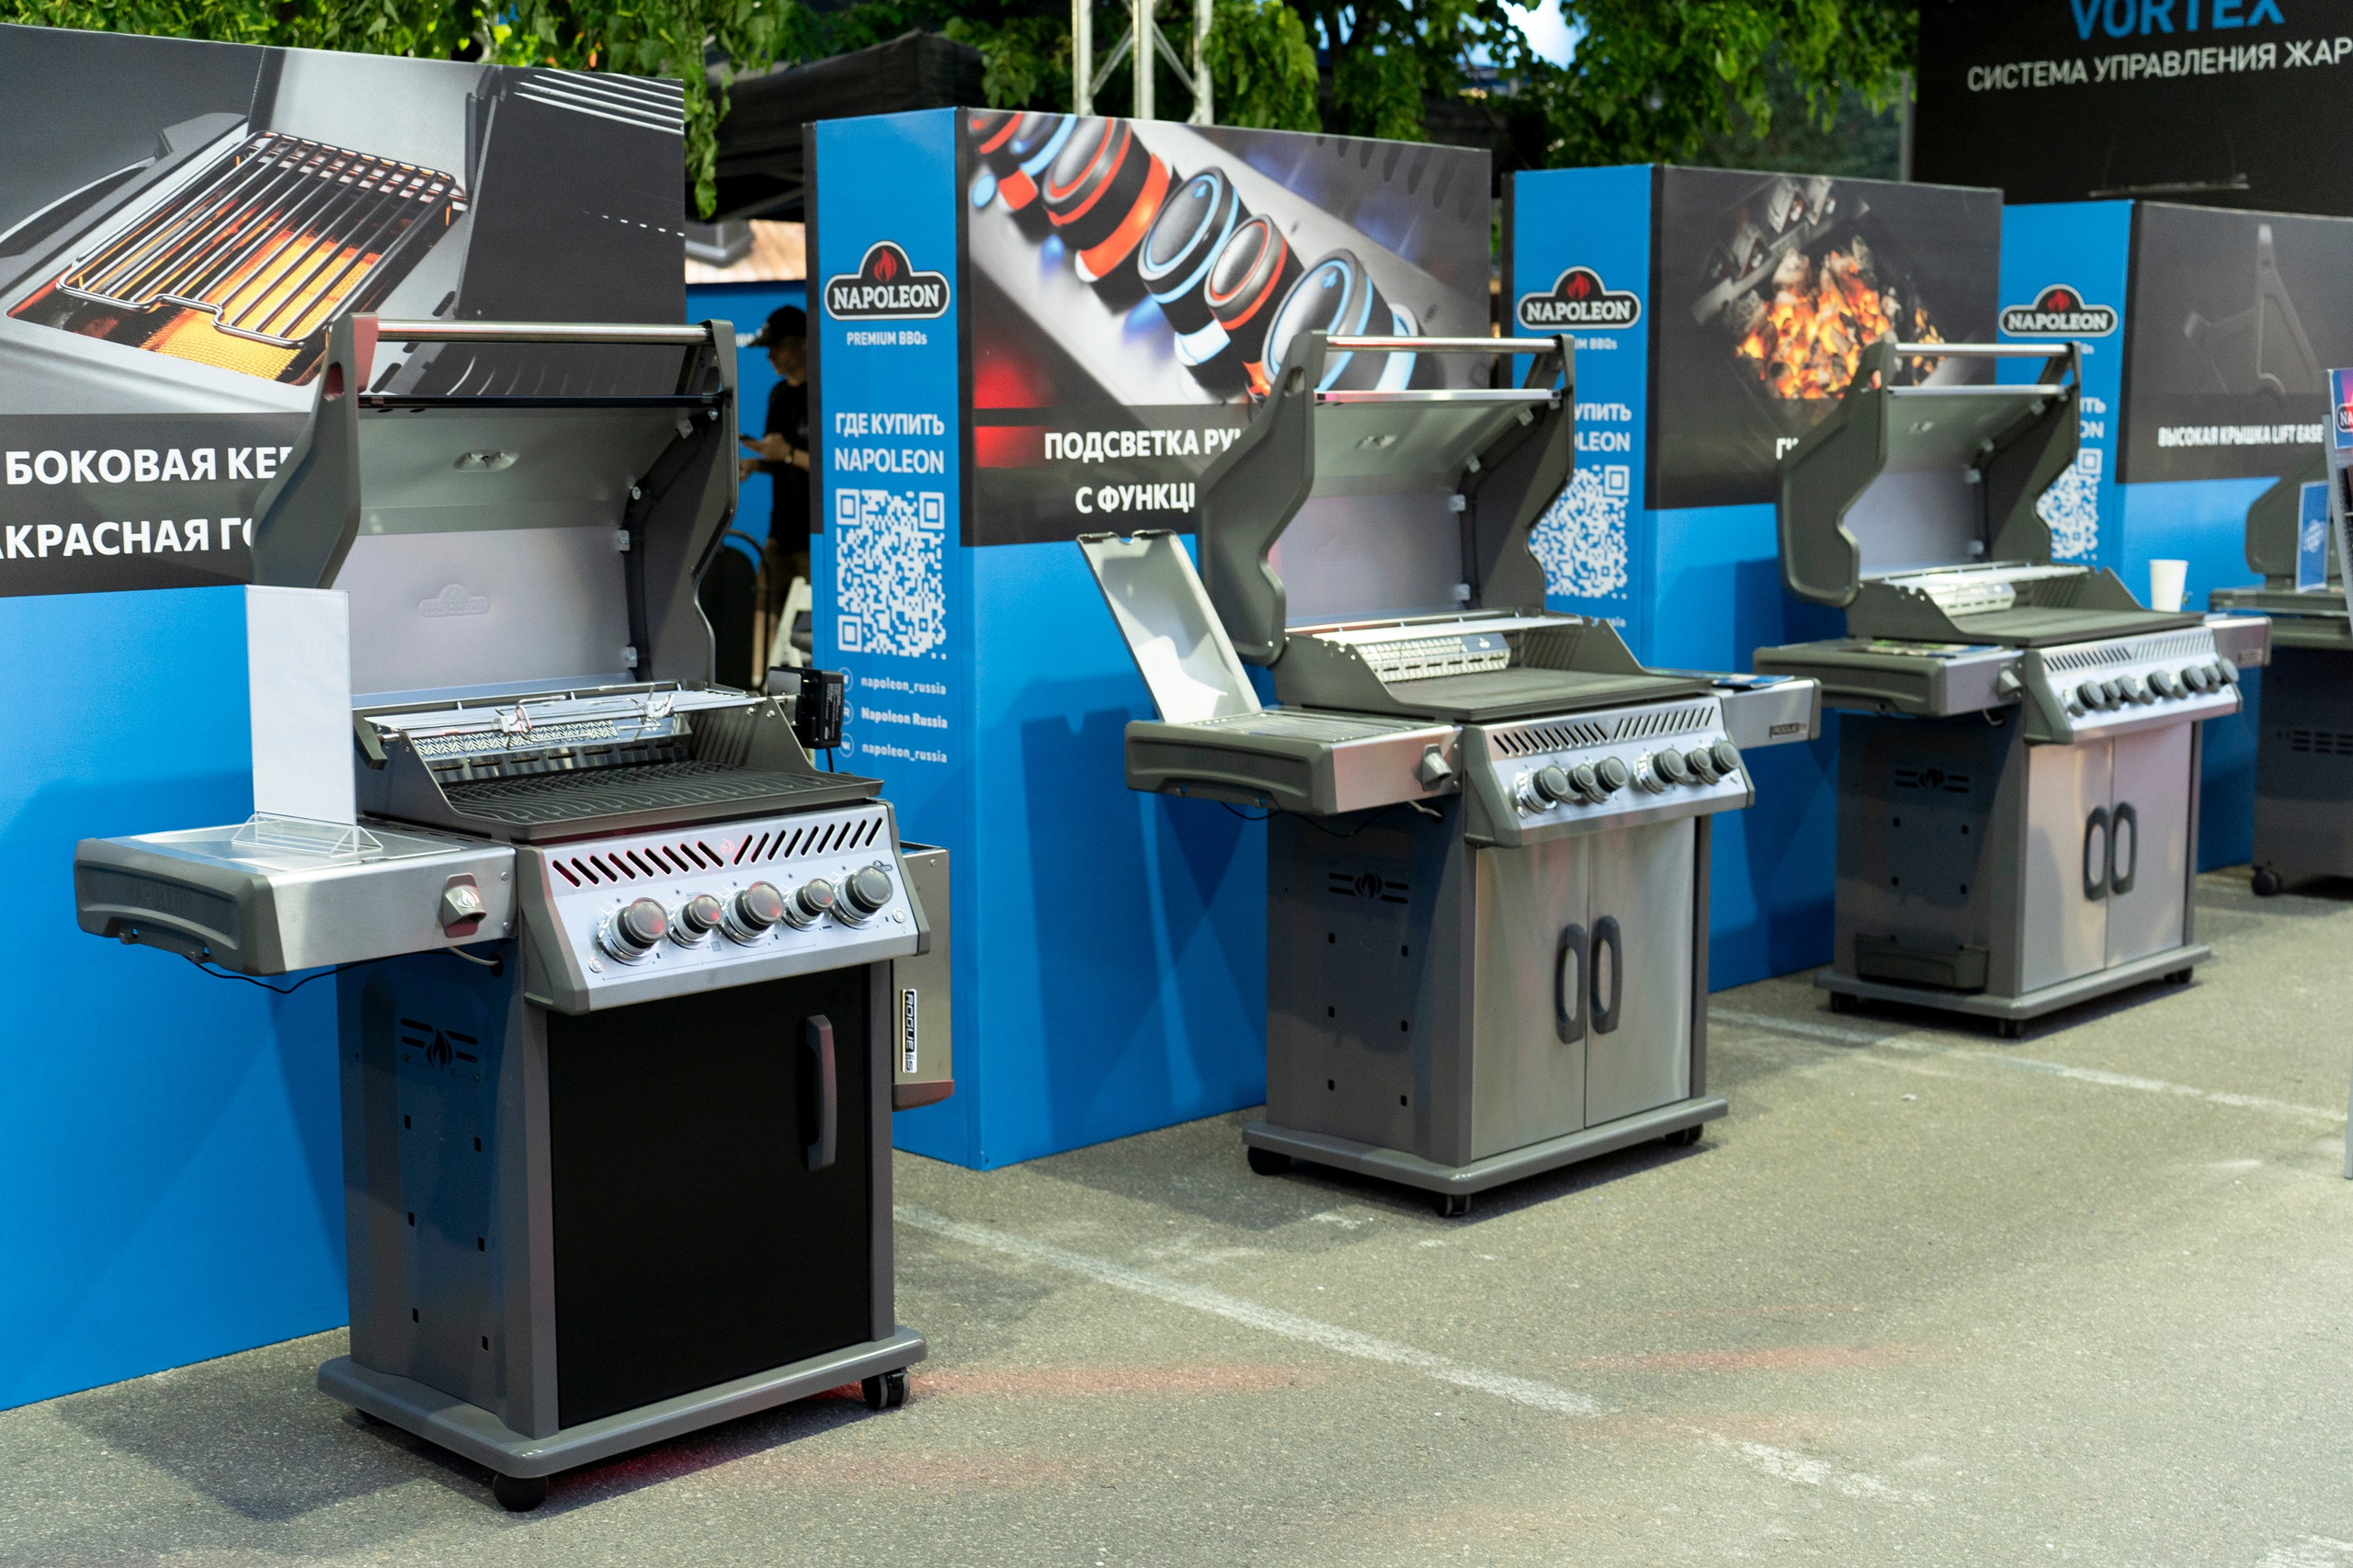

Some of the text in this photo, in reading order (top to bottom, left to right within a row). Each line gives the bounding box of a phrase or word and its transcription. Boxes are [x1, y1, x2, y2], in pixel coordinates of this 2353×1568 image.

[1967, 58, 2089, 92] СИСТЕМА
[2094, 42, 2277, 83] УПРАВЛЕНИЯ
[833, 284, 940, 311] NAPOLEON
[1526, 300, 1632, 322] NAPOLEON
[2007, 312, 2109, 331] NAPOLEON
[846, 330, 928, 347] PREMIUM BBQs
[835, 412, 946, 438] ГДЕ КУПИТЬ
[1044, 428, 1199, 463] ПОДСВЕТКА
[6, 448, 217, 484] БОКОВАЯ
[834, 447, 945, 474] NAPOLEON
[1074, 486, 1093, 514] С
[0, 518, 210, 559] КРАСНАЯ
[860, 676, 947, 696] napoleon_russia
[860, 706, 949, 729] Napoleon Russia
[861, 743, 948, 764] napoleon_russia
[905, 993, 915, 1051] ROGUE
